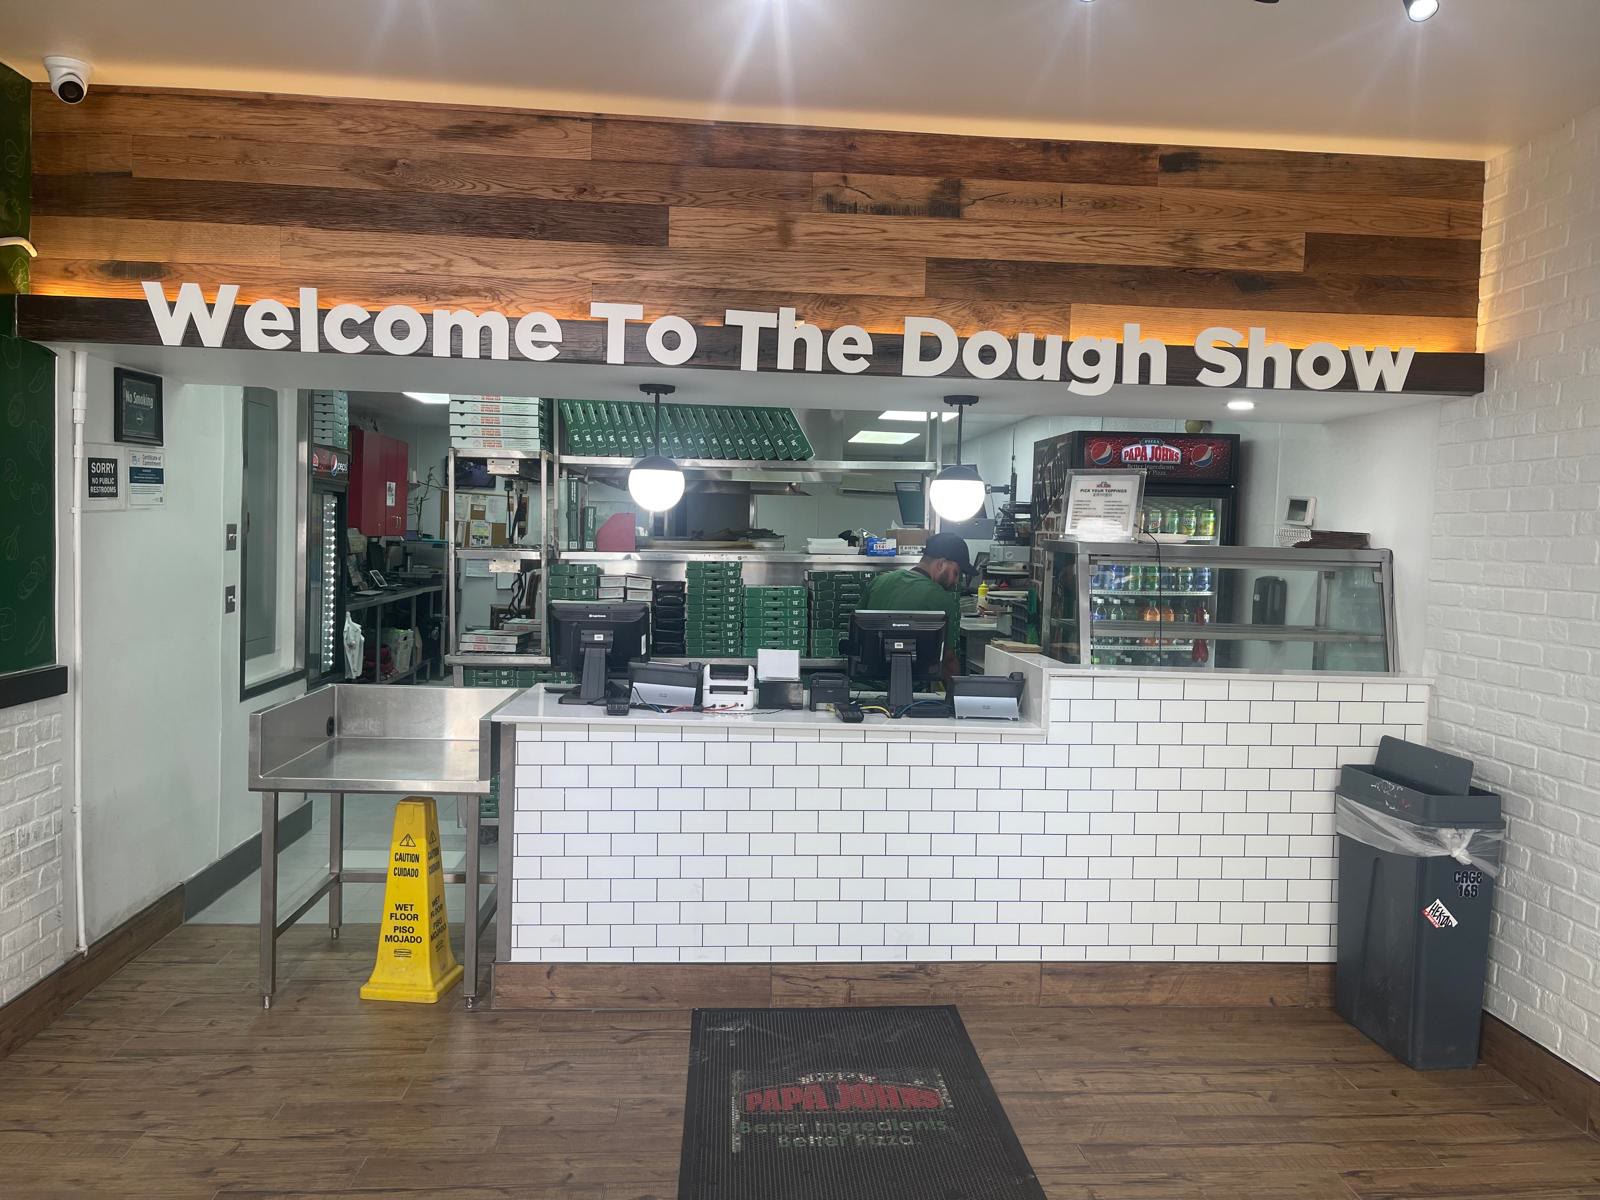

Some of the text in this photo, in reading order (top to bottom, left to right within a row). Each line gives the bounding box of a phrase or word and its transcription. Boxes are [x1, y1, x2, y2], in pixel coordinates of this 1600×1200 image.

[142, 281, 1415, 397] Welcome To The Dough Show
[126, 390, 153, 408] No Smoking
[1124, 446, 1179, 462] PAPA JOHNS
[91, 462, 115, 474] SORRY
[394, 852, 419, 863] CAUTION
[394, 868, 418, 878] CUIDADO
[1458, 885, 1478, 897] 168
[390, 913, 419, 921] FLOOR
[385, 935, 422, 944] MOJADO
[746, 1082, 941, 1112] PAPA JOHNS
[739, 1121, 804, 1134] Better
[778, 1136, 844, 1148] Better
